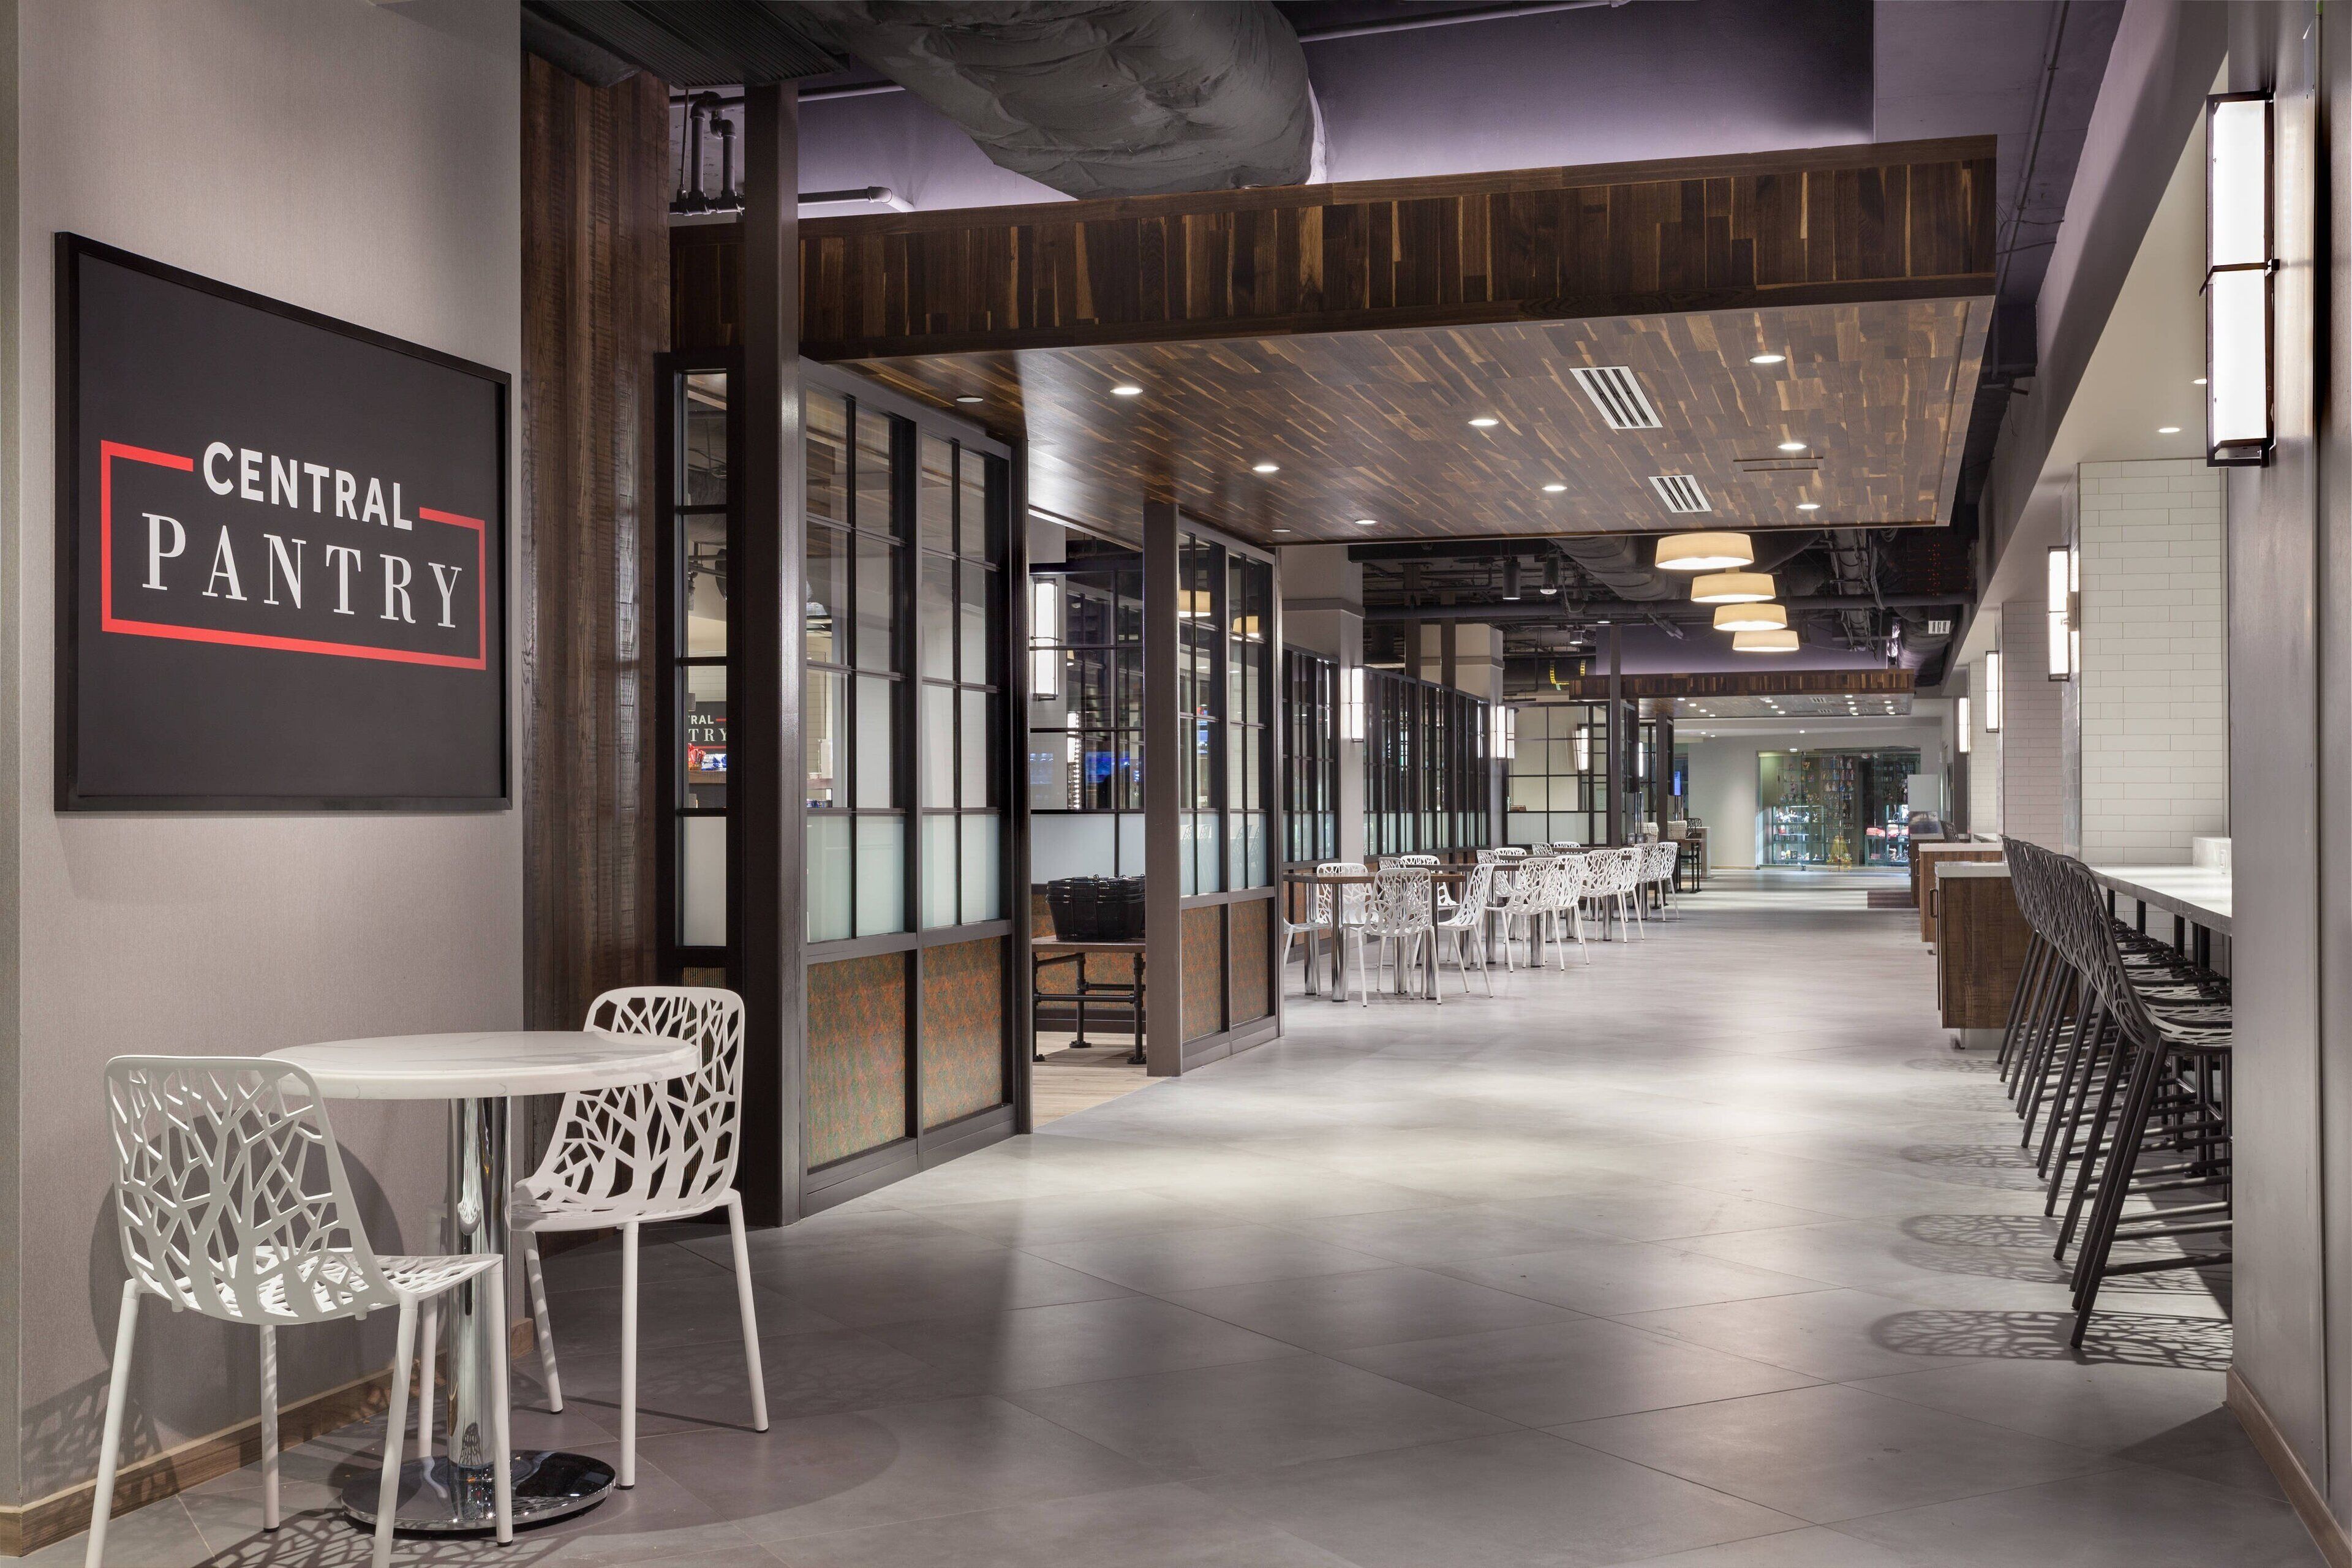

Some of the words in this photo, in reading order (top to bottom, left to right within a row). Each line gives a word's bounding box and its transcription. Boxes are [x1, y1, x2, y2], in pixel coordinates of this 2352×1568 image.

[203, 442, 412, 530] CENTRAL
[142, 513, 462, 628] PANTRY
[688, 715, 714, 725] RAL
